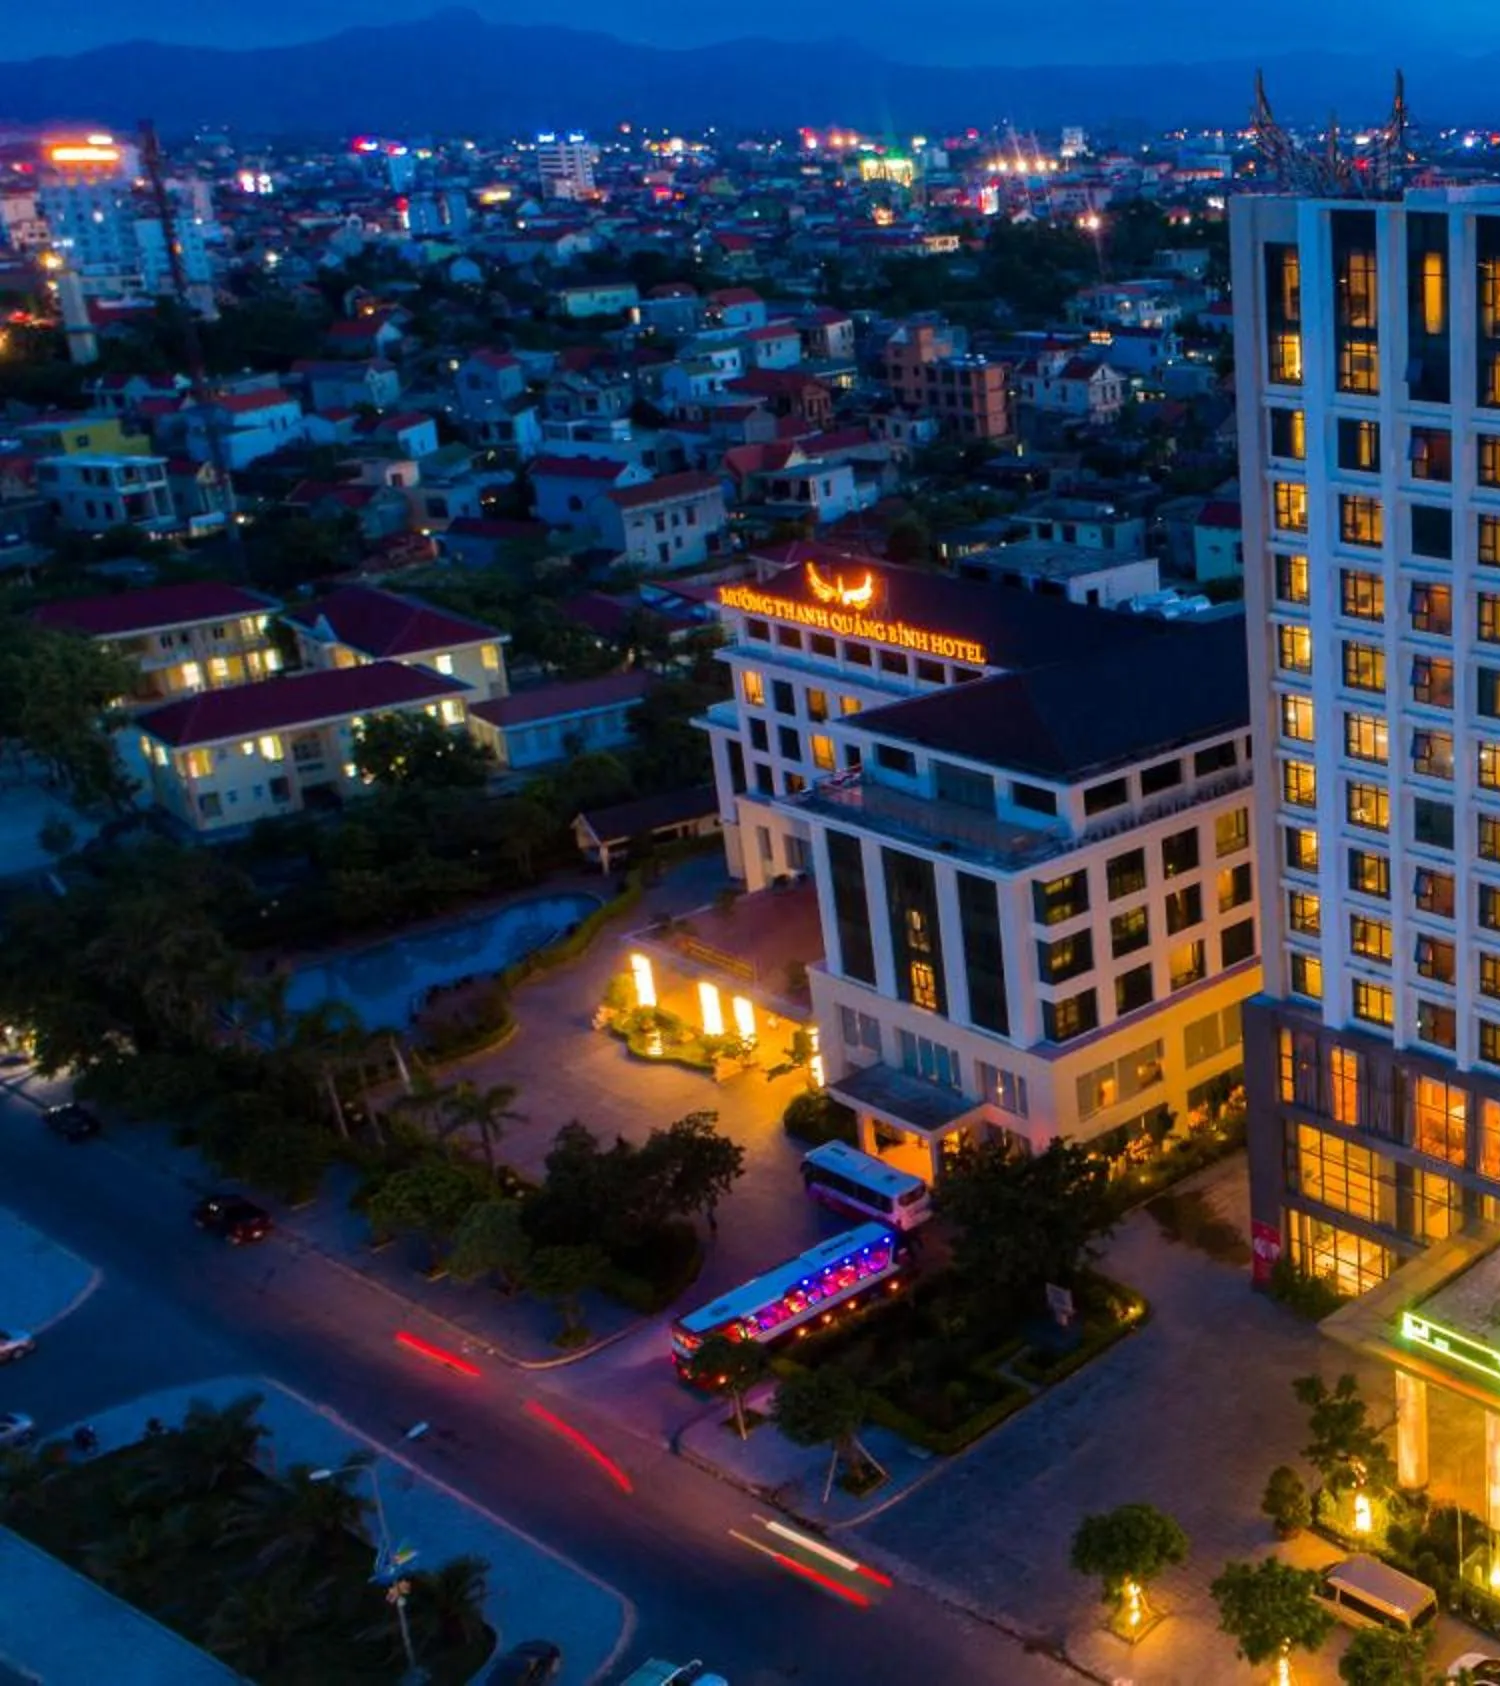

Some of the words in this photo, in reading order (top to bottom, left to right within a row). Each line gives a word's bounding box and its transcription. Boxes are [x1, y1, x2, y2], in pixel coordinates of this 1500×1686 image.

[774, 598, 829, 628] THANH
[830, 612, 886, 642] QUẢNG
[887, 621, 929, 651] BÌNH
[930, 634, 986, 664] HOTEL
